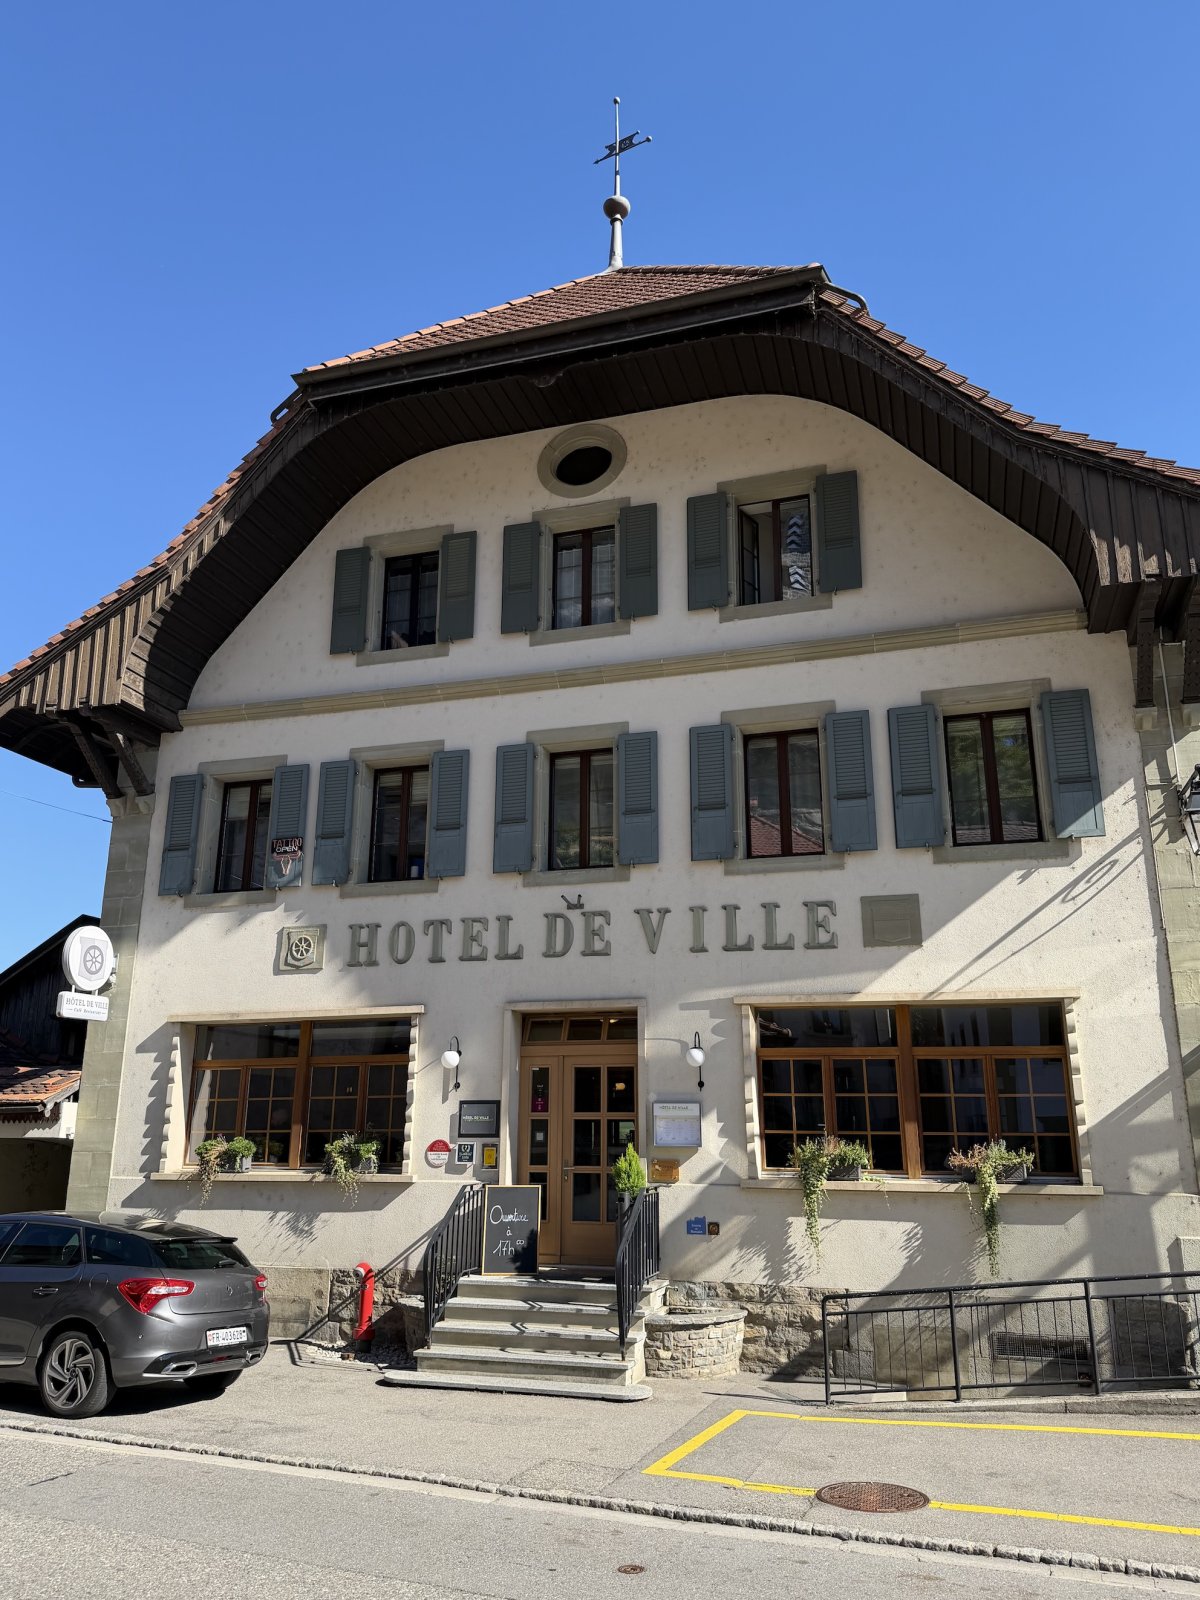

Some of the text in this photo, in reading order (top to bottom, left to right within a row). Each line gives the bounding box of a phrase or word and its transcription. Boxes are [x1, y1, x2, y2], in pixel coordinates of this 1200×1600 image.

[272, 837, 302, 848] TATTOO
[346, 900, 838, 967] HOTEL DE VILLE
[66, 997, 85, 1006] HÔTEL
[86, 1000, 94, 1008] DE
[490, 1205, 529, 1225] Ouverture
